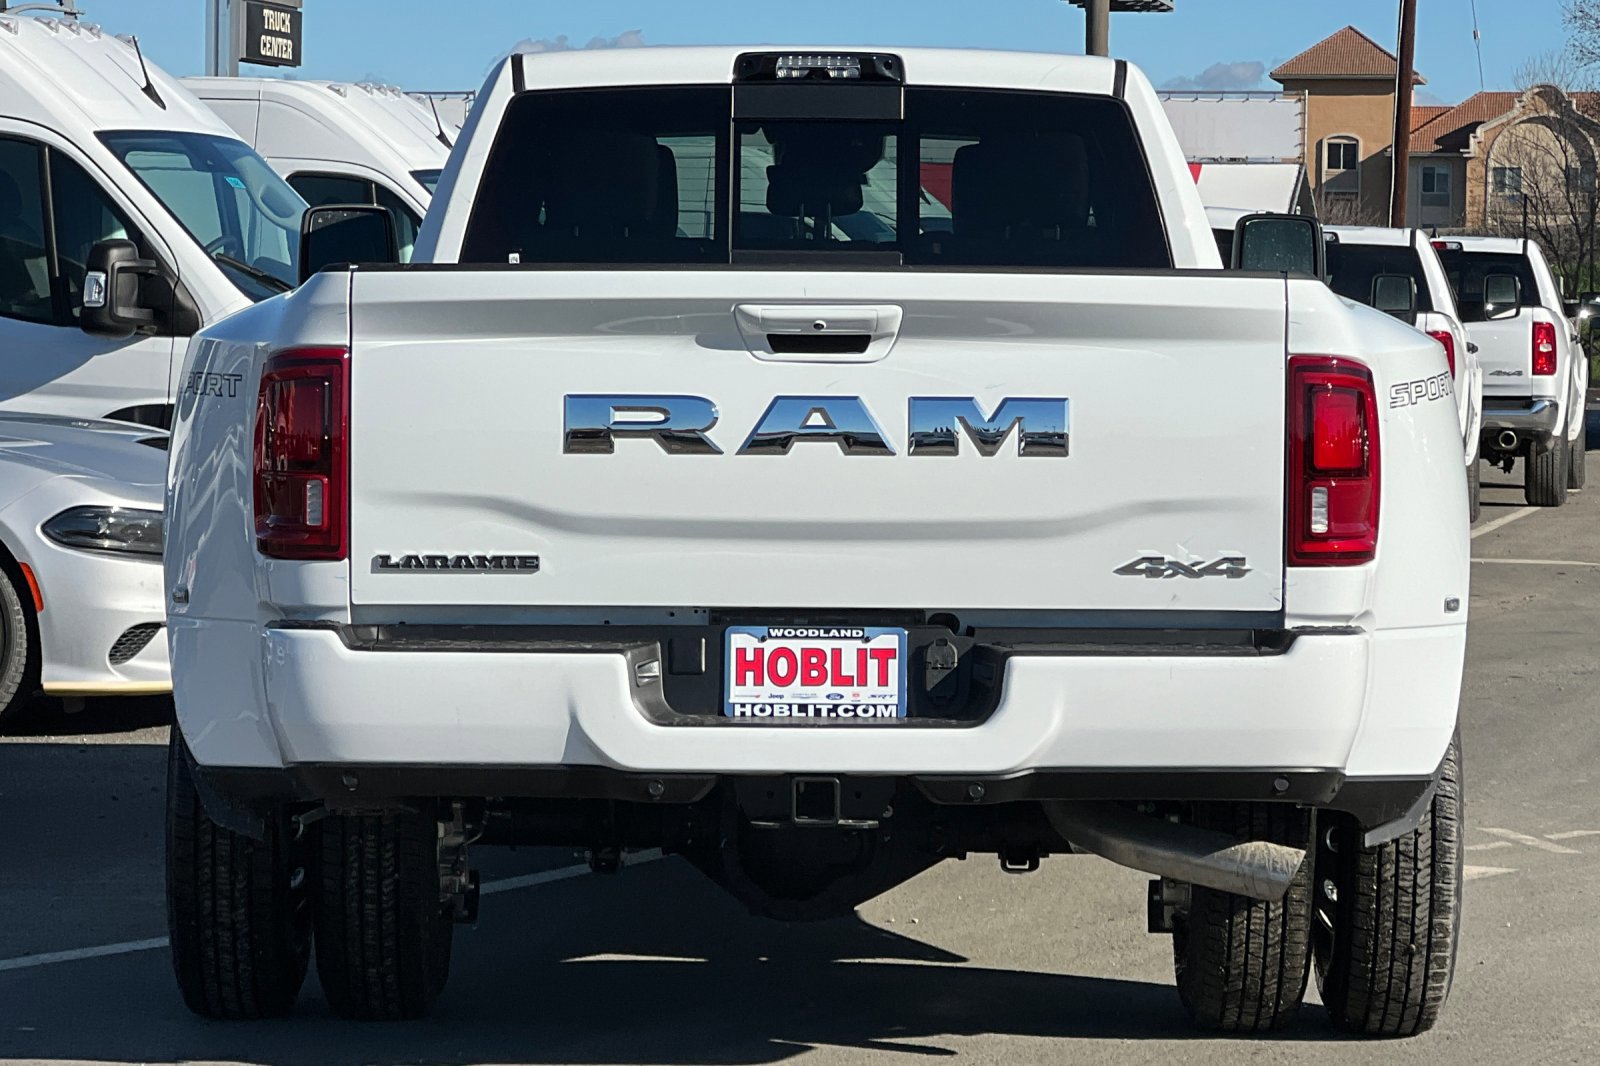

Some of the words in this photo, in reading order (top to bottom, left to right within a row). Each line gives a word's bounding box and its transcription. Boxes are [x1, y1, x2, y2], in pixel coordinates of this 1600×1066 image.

[263, 8, 291, 34] TRUCK
[260, 34, 293, 60] CENTER
[563, 394, 1069, 457] RAM
[371, 554, 540, 574] LARAMIE
[768, 628, 864, 638] WOODLAND
[735, 646, 897, 687] HOBLIT
[734, 703, 897, 718] HOBLIT.COM
